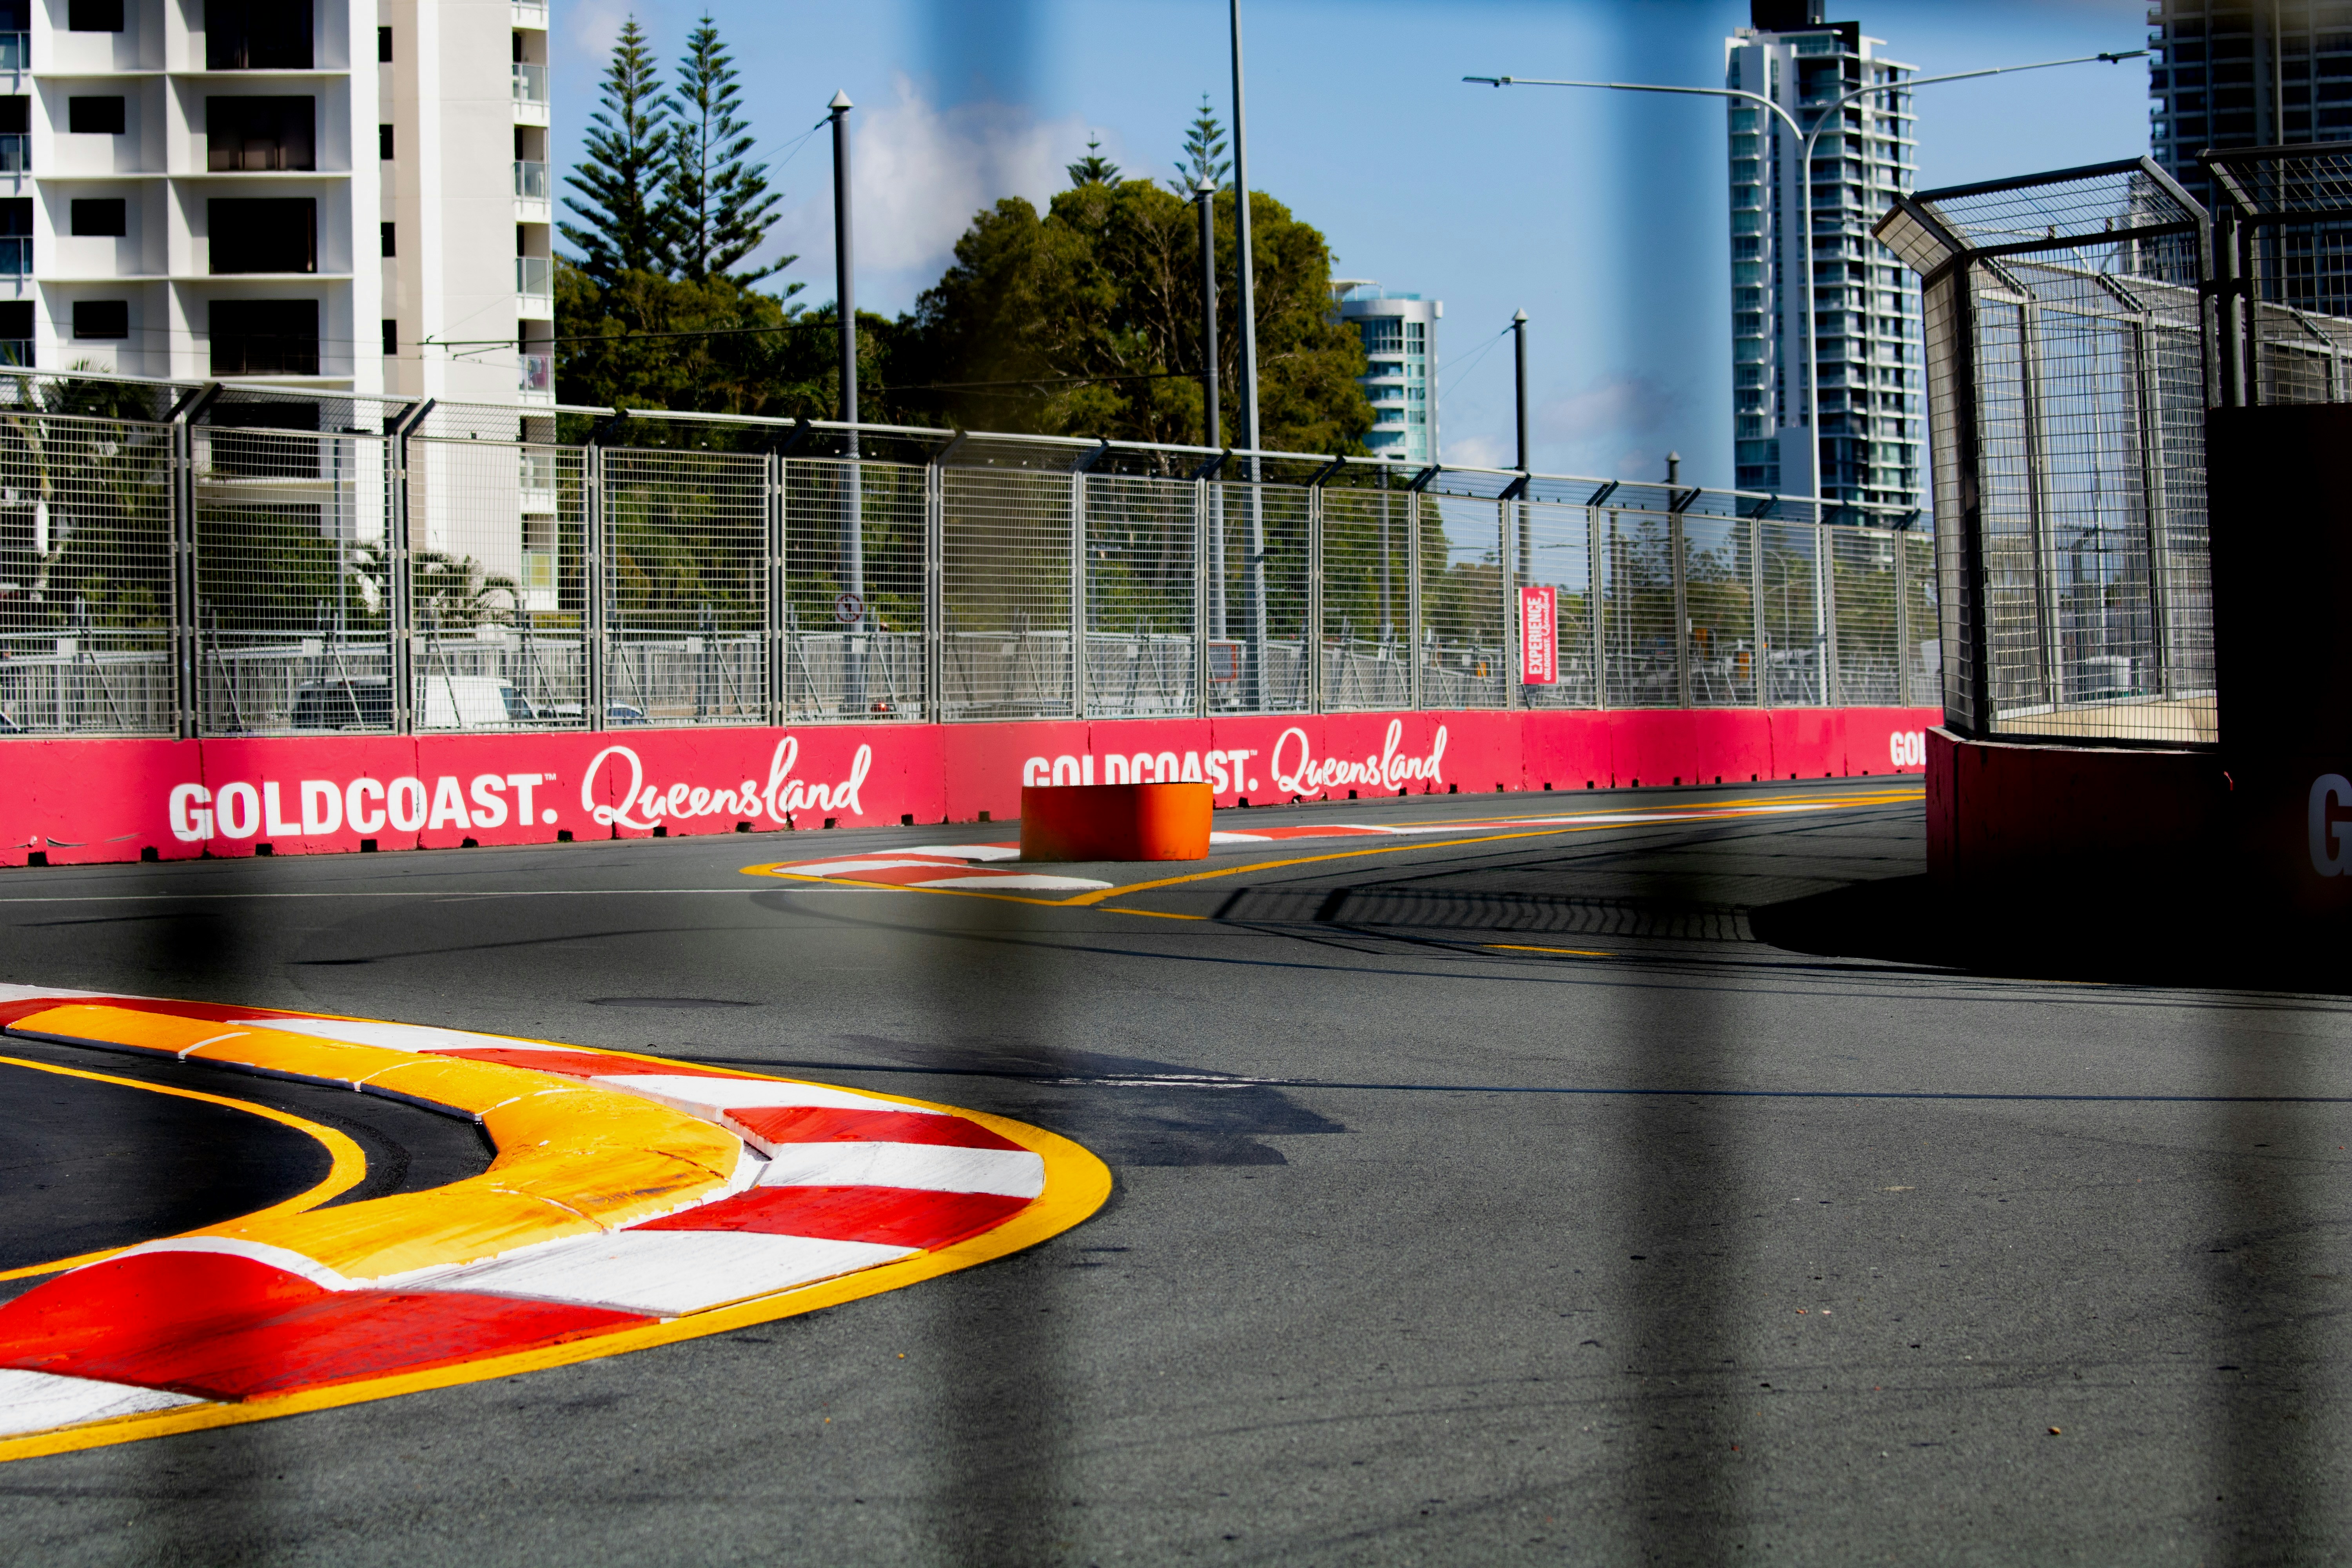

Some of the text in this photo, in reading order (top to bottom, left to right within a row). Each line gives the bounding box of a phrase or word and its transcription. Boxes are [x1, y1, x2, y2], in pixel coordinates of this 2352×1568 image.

[1527, 597, 1543, 674] EXPERIENCE
[1539, 590, 1551, 636] Queensland
[581, 736, 872, 830] Queensland
[1271, 719, 1447, 796] Queensland
